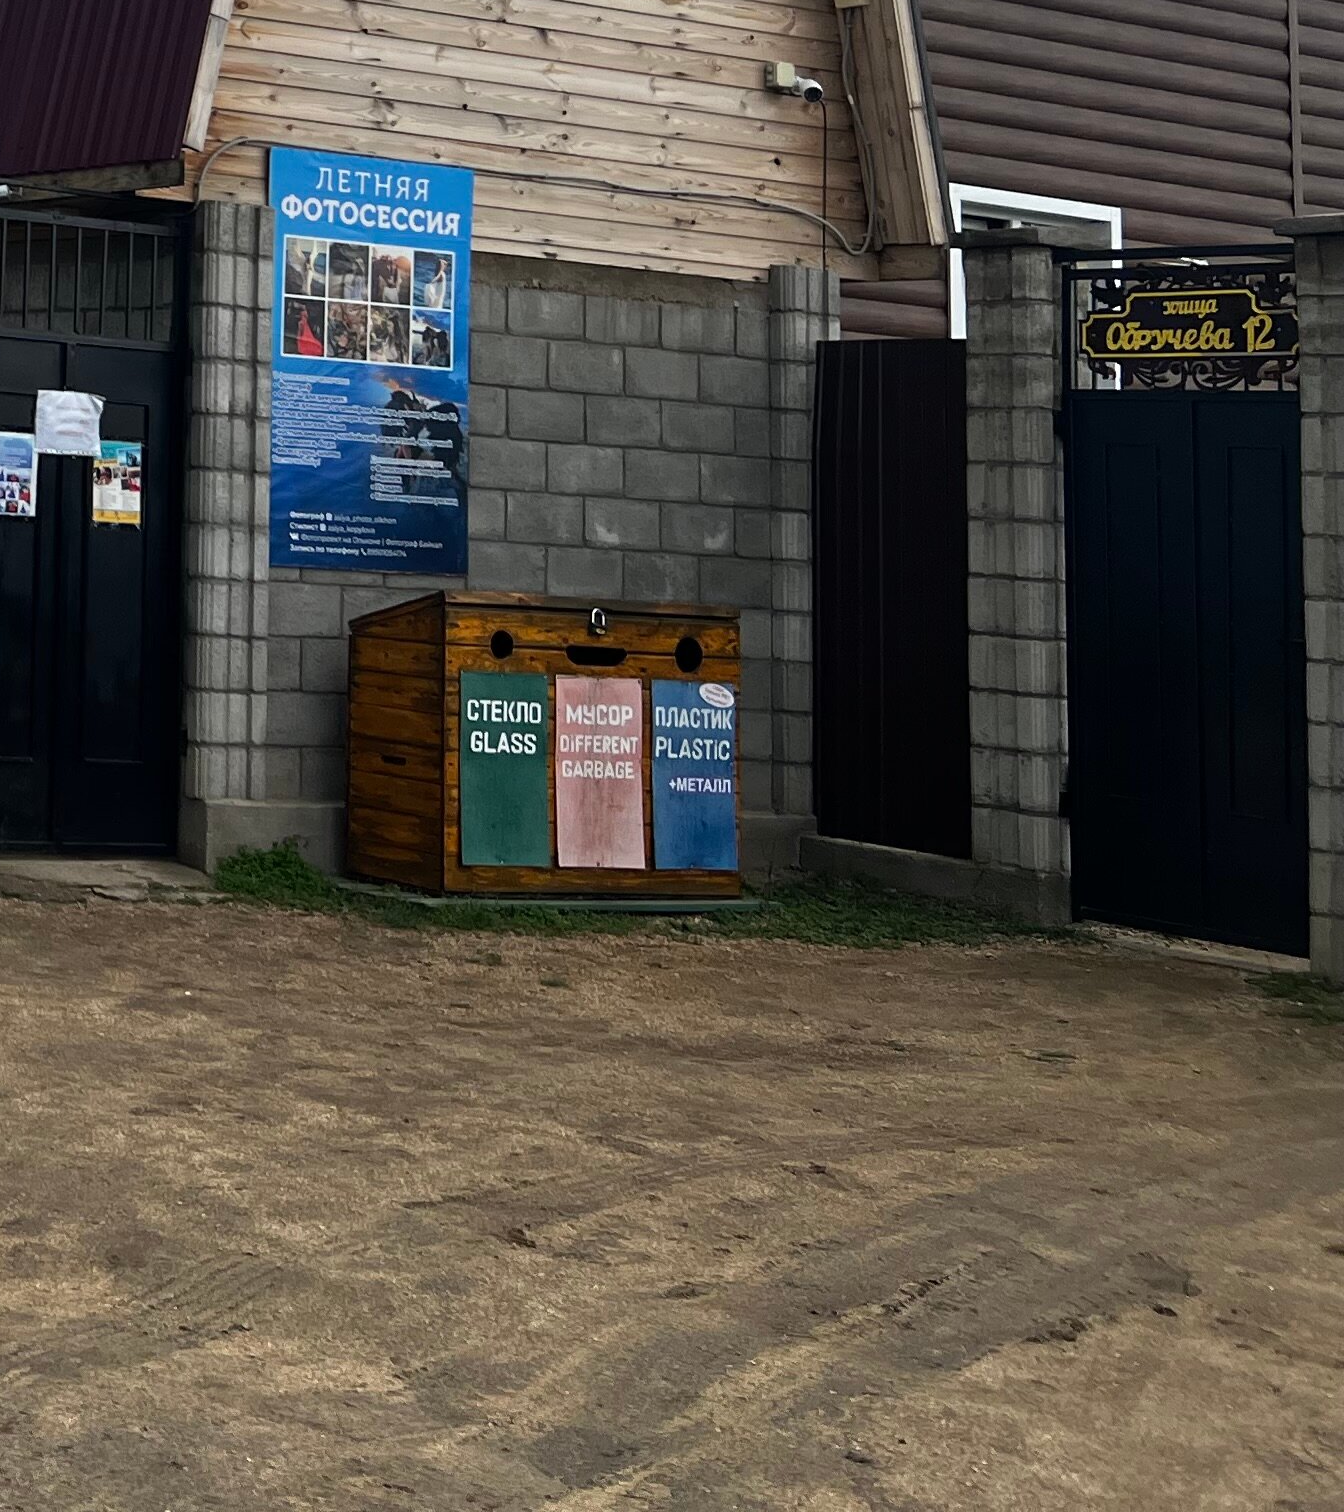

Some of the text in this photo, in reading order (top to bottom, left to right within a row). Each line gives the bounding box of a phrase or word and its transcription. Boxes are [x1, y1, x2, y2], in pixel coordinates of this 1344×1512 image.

[316, 167, 430, 202] ЛЕТНЯЯ
[281, 194, 461, 237] ФОТОСЕССИЯ
[1106, 313, 1276, 353] Обручева 12
[467, 699, 542, 724] СТЕКЛО
[565, 703, 634, 727] МУСОР
[655, 706, 733, 730] ПЛАСТИК
[470, 731, 537, 755] GLASS
[655, 736, 731, 761] PLASTIC
[562, 760, 635, 780] GARBAGE
[669, 777, 732, 794] +МЕТАЛЛ
